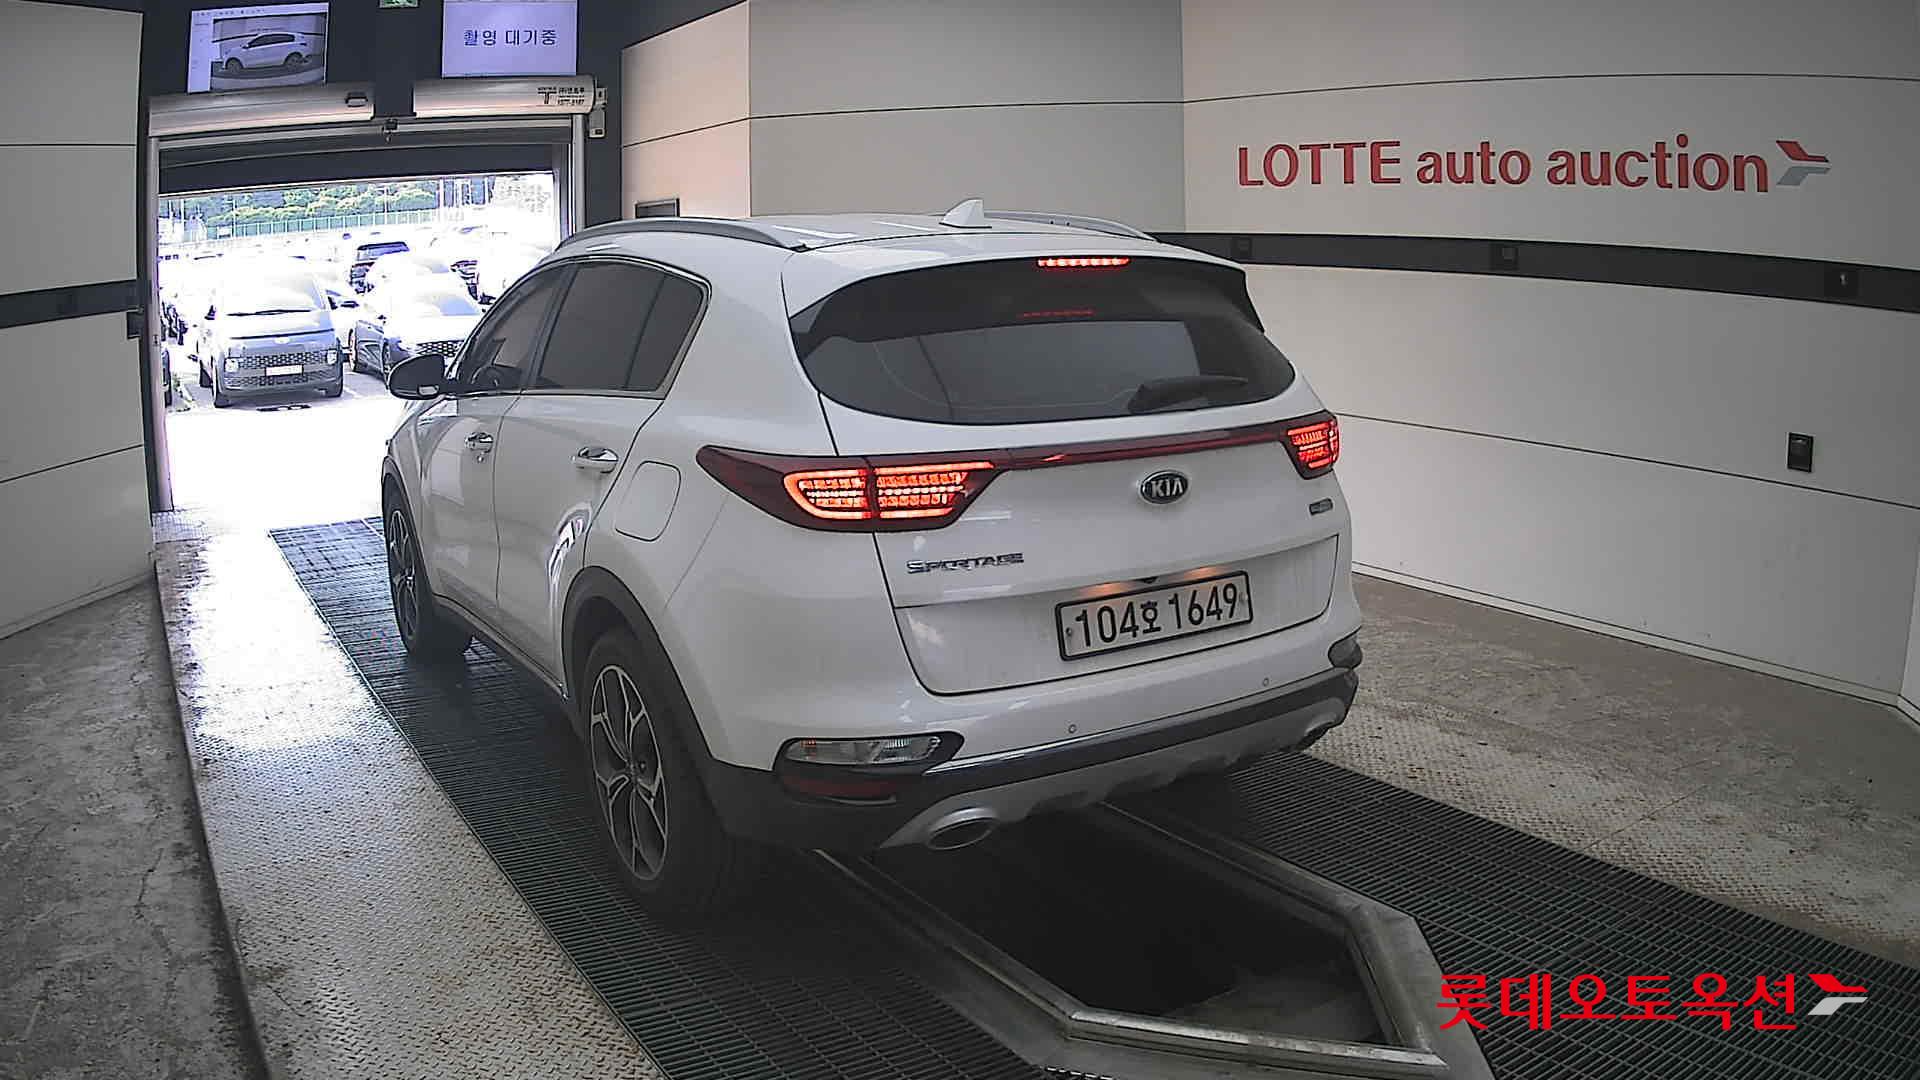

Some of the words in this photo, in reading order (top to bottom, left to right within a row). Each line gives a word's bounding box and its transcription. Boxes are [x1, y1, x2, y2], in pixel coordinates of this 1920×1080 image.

[504, 29, 557, 47] 대기중
[1237, 140, 1401, 187] LOTTE
[1415, 140, 1532, 185] auto
[1545, 134, 1769, 193] auction
[1151, 477, 1184, 497] KIA
[905, 552, 1025, 575] SPORTAGE
